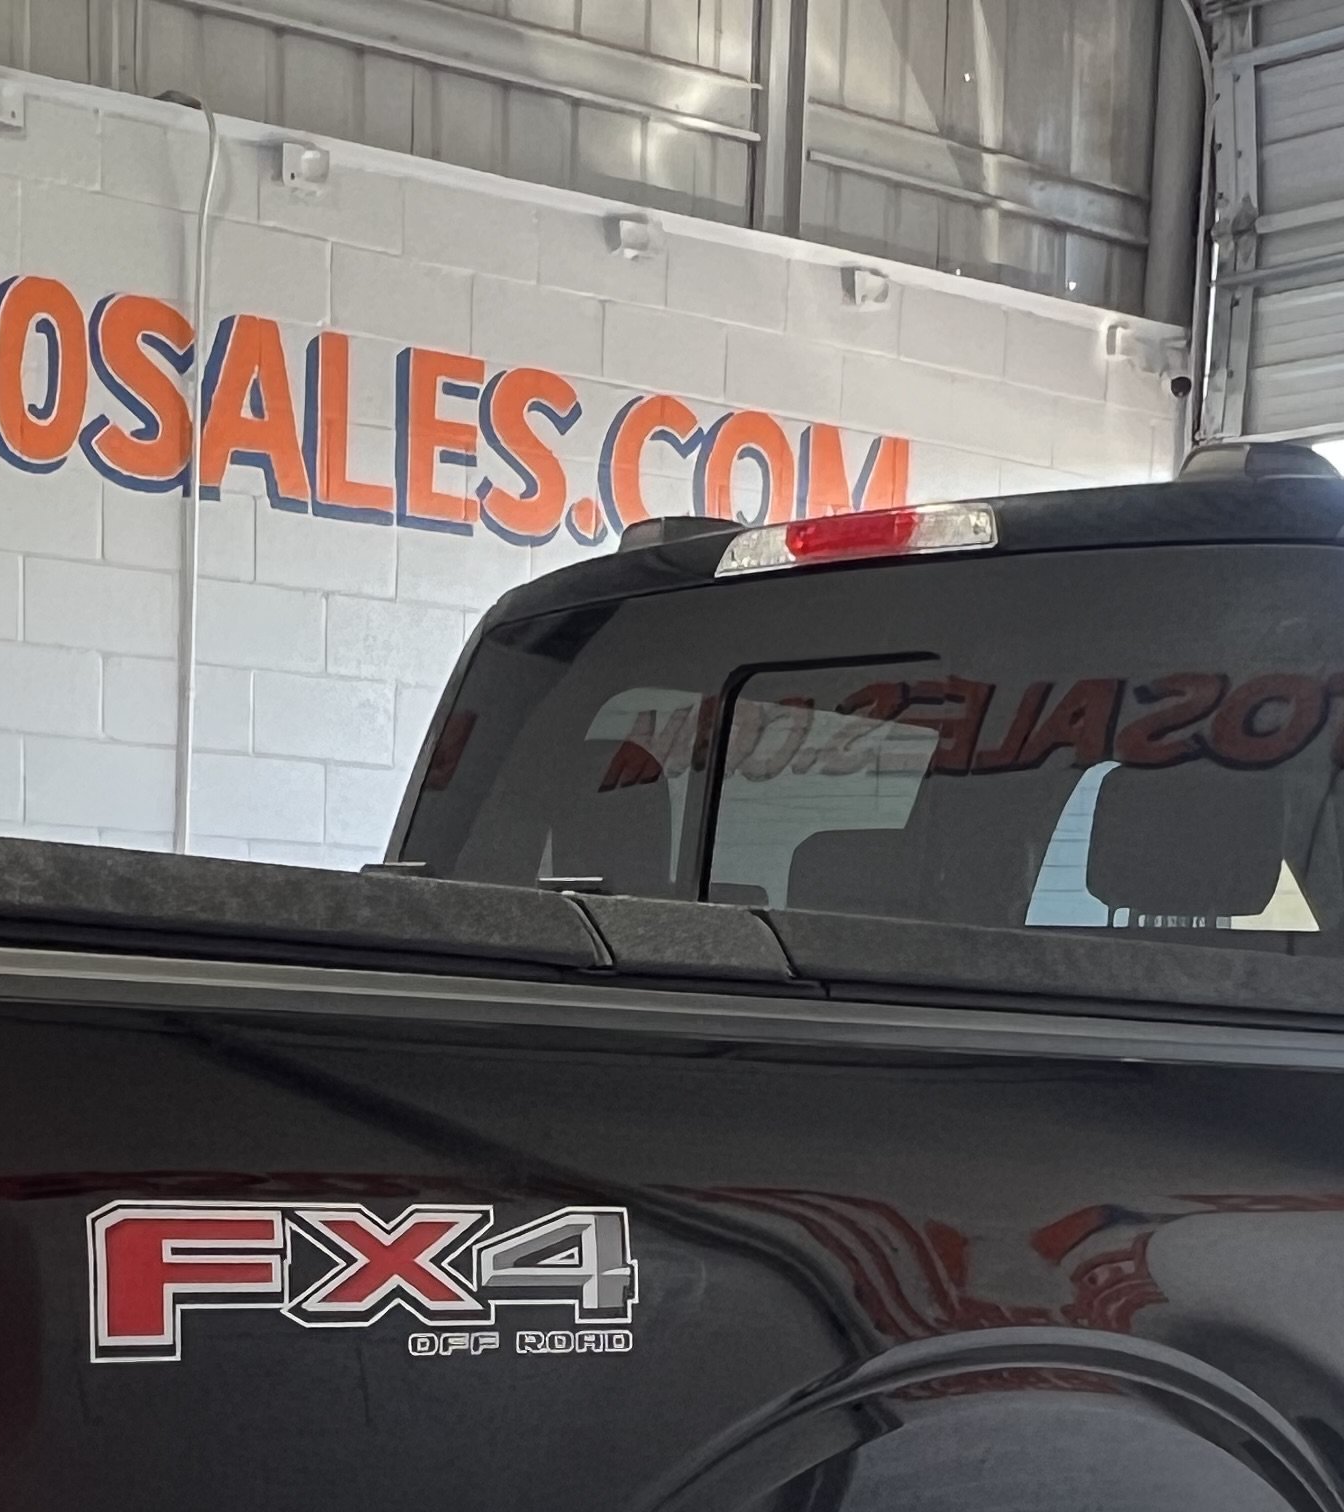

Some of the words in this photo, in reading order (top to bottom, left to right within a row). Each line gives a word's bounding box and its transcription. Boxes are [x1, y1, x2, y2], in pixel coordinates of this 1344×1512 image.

[86, 1199, 639, 1361] FX4
[407, 1330, 500, 1356] OFF
[516, 1329, 634, 1354] ROAD
